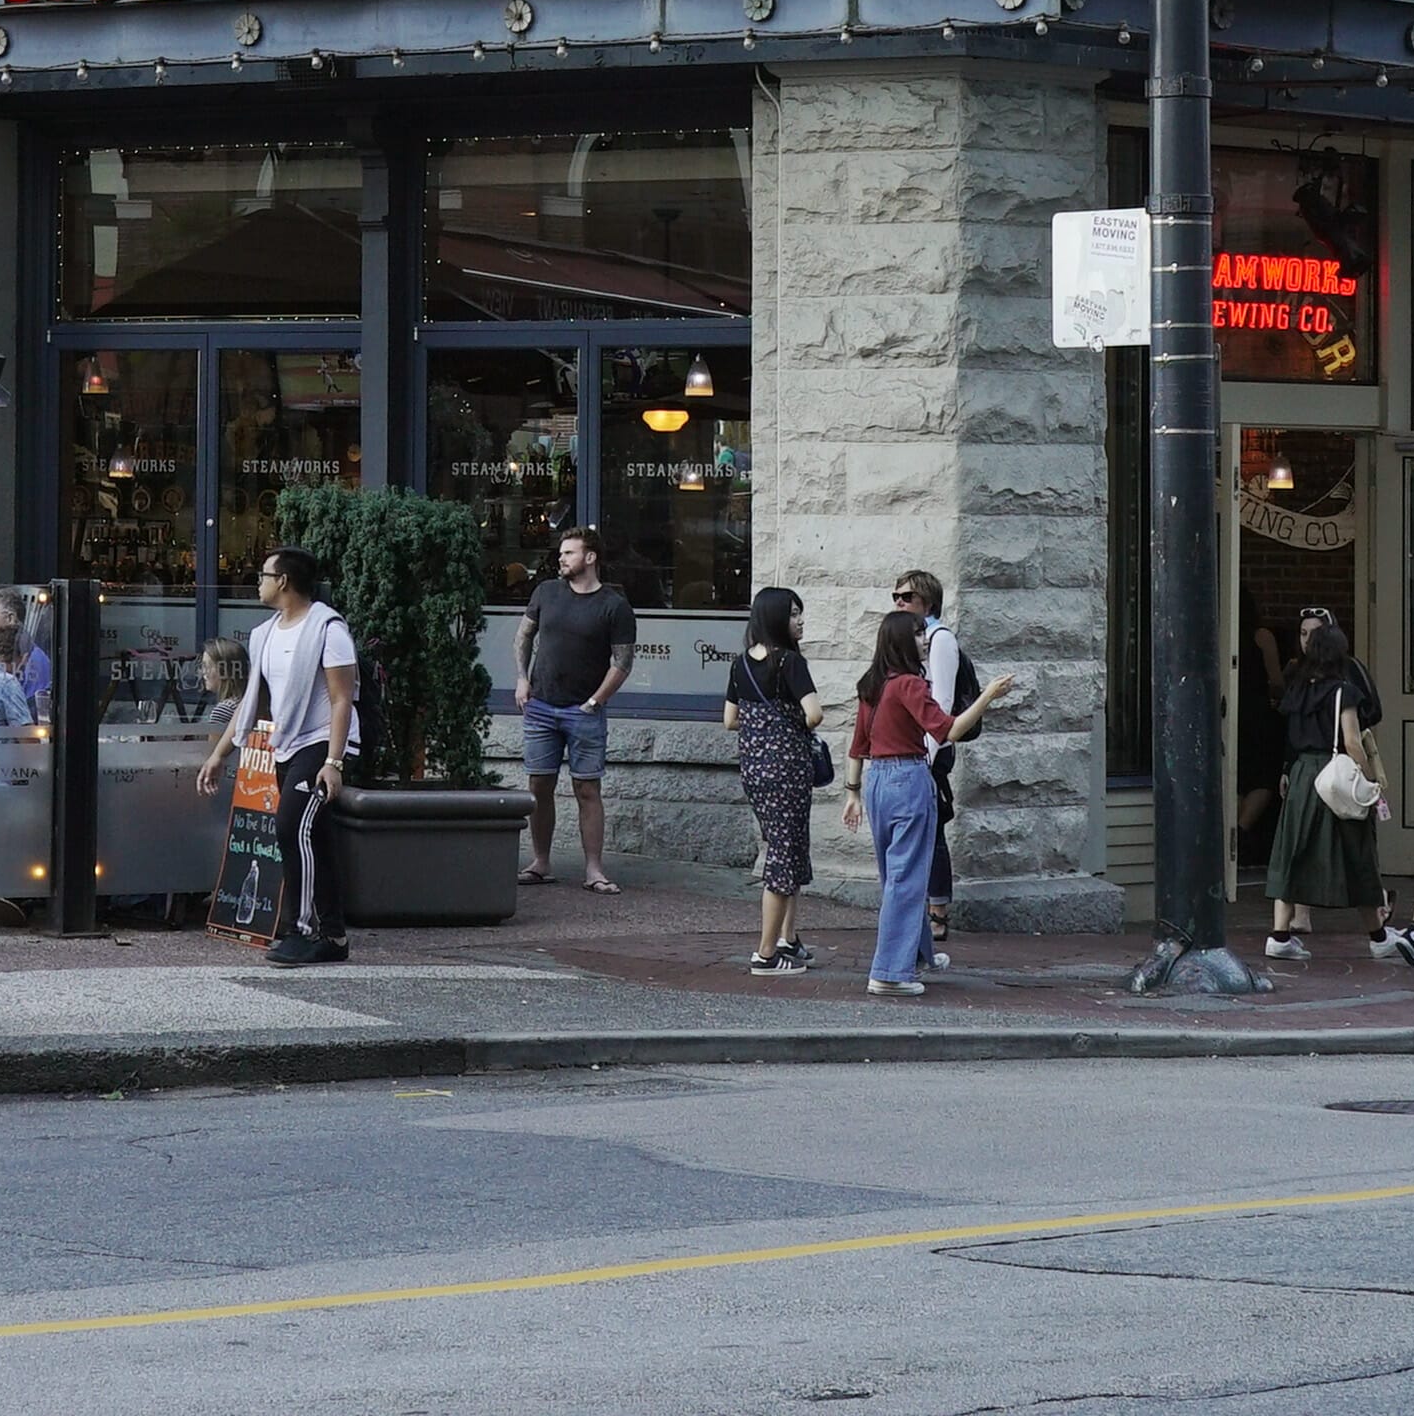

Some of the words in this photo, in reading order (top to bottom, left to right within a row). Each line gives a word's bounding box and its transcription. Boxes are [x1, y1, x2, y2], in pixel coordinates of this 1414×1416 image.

[1094, 216, 1137, 229] EASTVAN
[1092, 227, 1136, 241] MOVING
[1299, 305, 1334, 333] CO.
[242, 460, 340, 473] STEAMWORKS
[627, 463, 734, 477] STEAMWORKS
[1240, 498, 1295, 542] ING
[1305, 520, 1348, 546] CO.
[635, 645, 671, 655] PRESS
